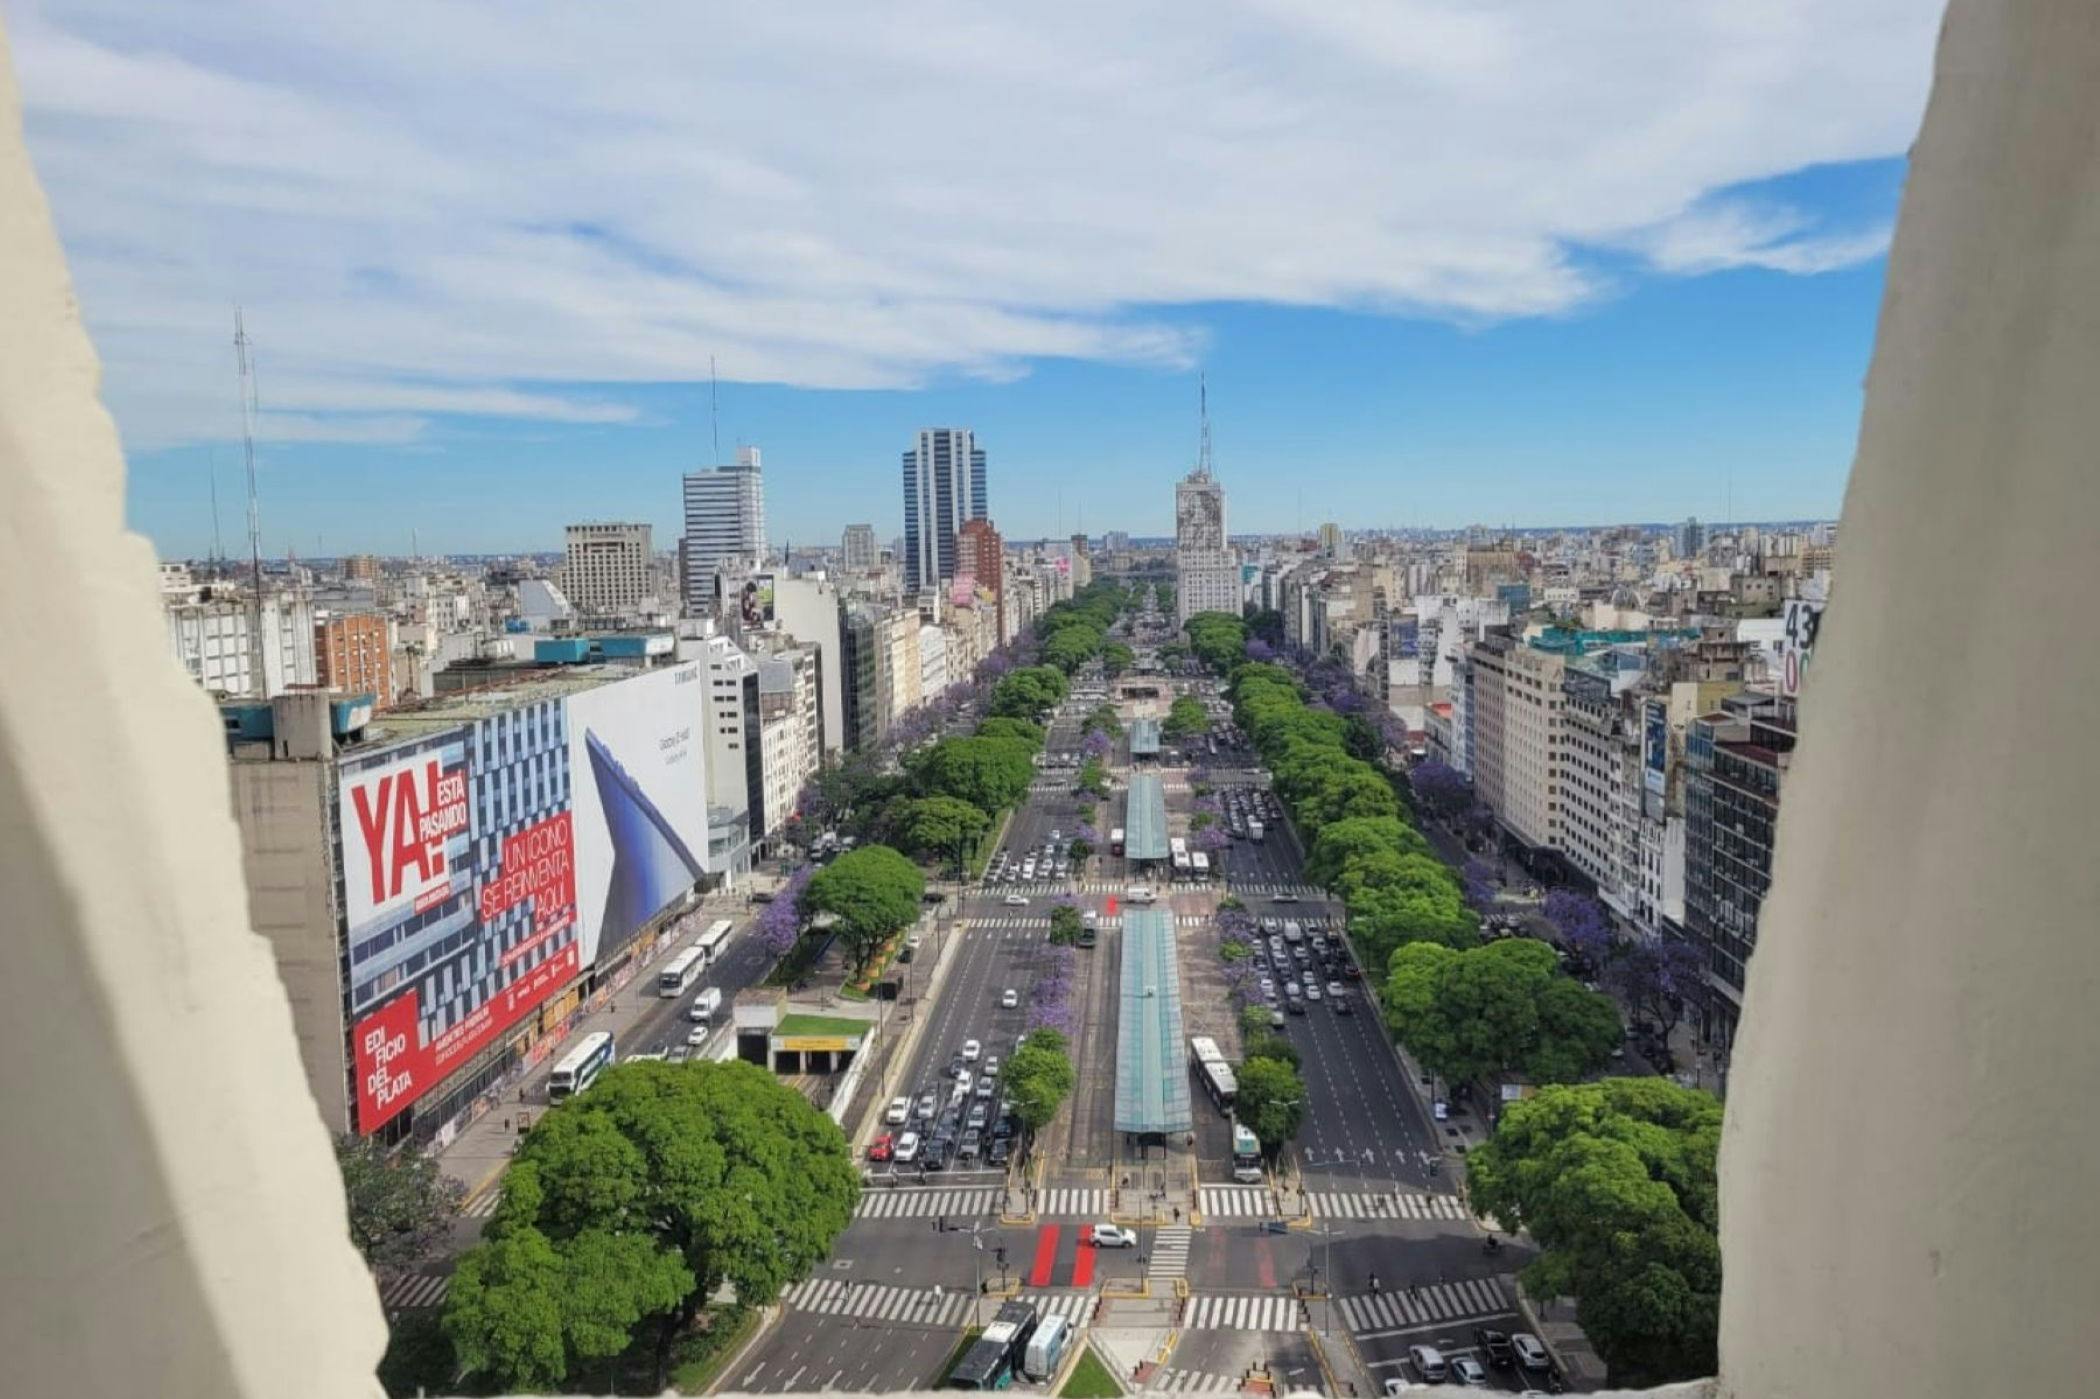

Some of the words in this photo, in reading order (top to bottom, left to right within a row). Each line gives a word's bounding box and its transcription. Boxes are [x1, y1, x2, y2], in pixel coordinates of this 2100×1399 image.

[438, 770, 465, 806] ESTÁ
[351, 760, 445, 905] YA!
[420, 801, 467, 842] PASANDO
[505, 839, 526, 873] UN
[483, 882, 503, 919] SE
[504, 848, 570, 906] REINVENTA
[365, 1026, 386, 1056] EDI
[376, 1033, 406, 1069] FICIO
[368, 1066, 393, 1096] DEL
[377, 1070, 413, 1110] PLATA
